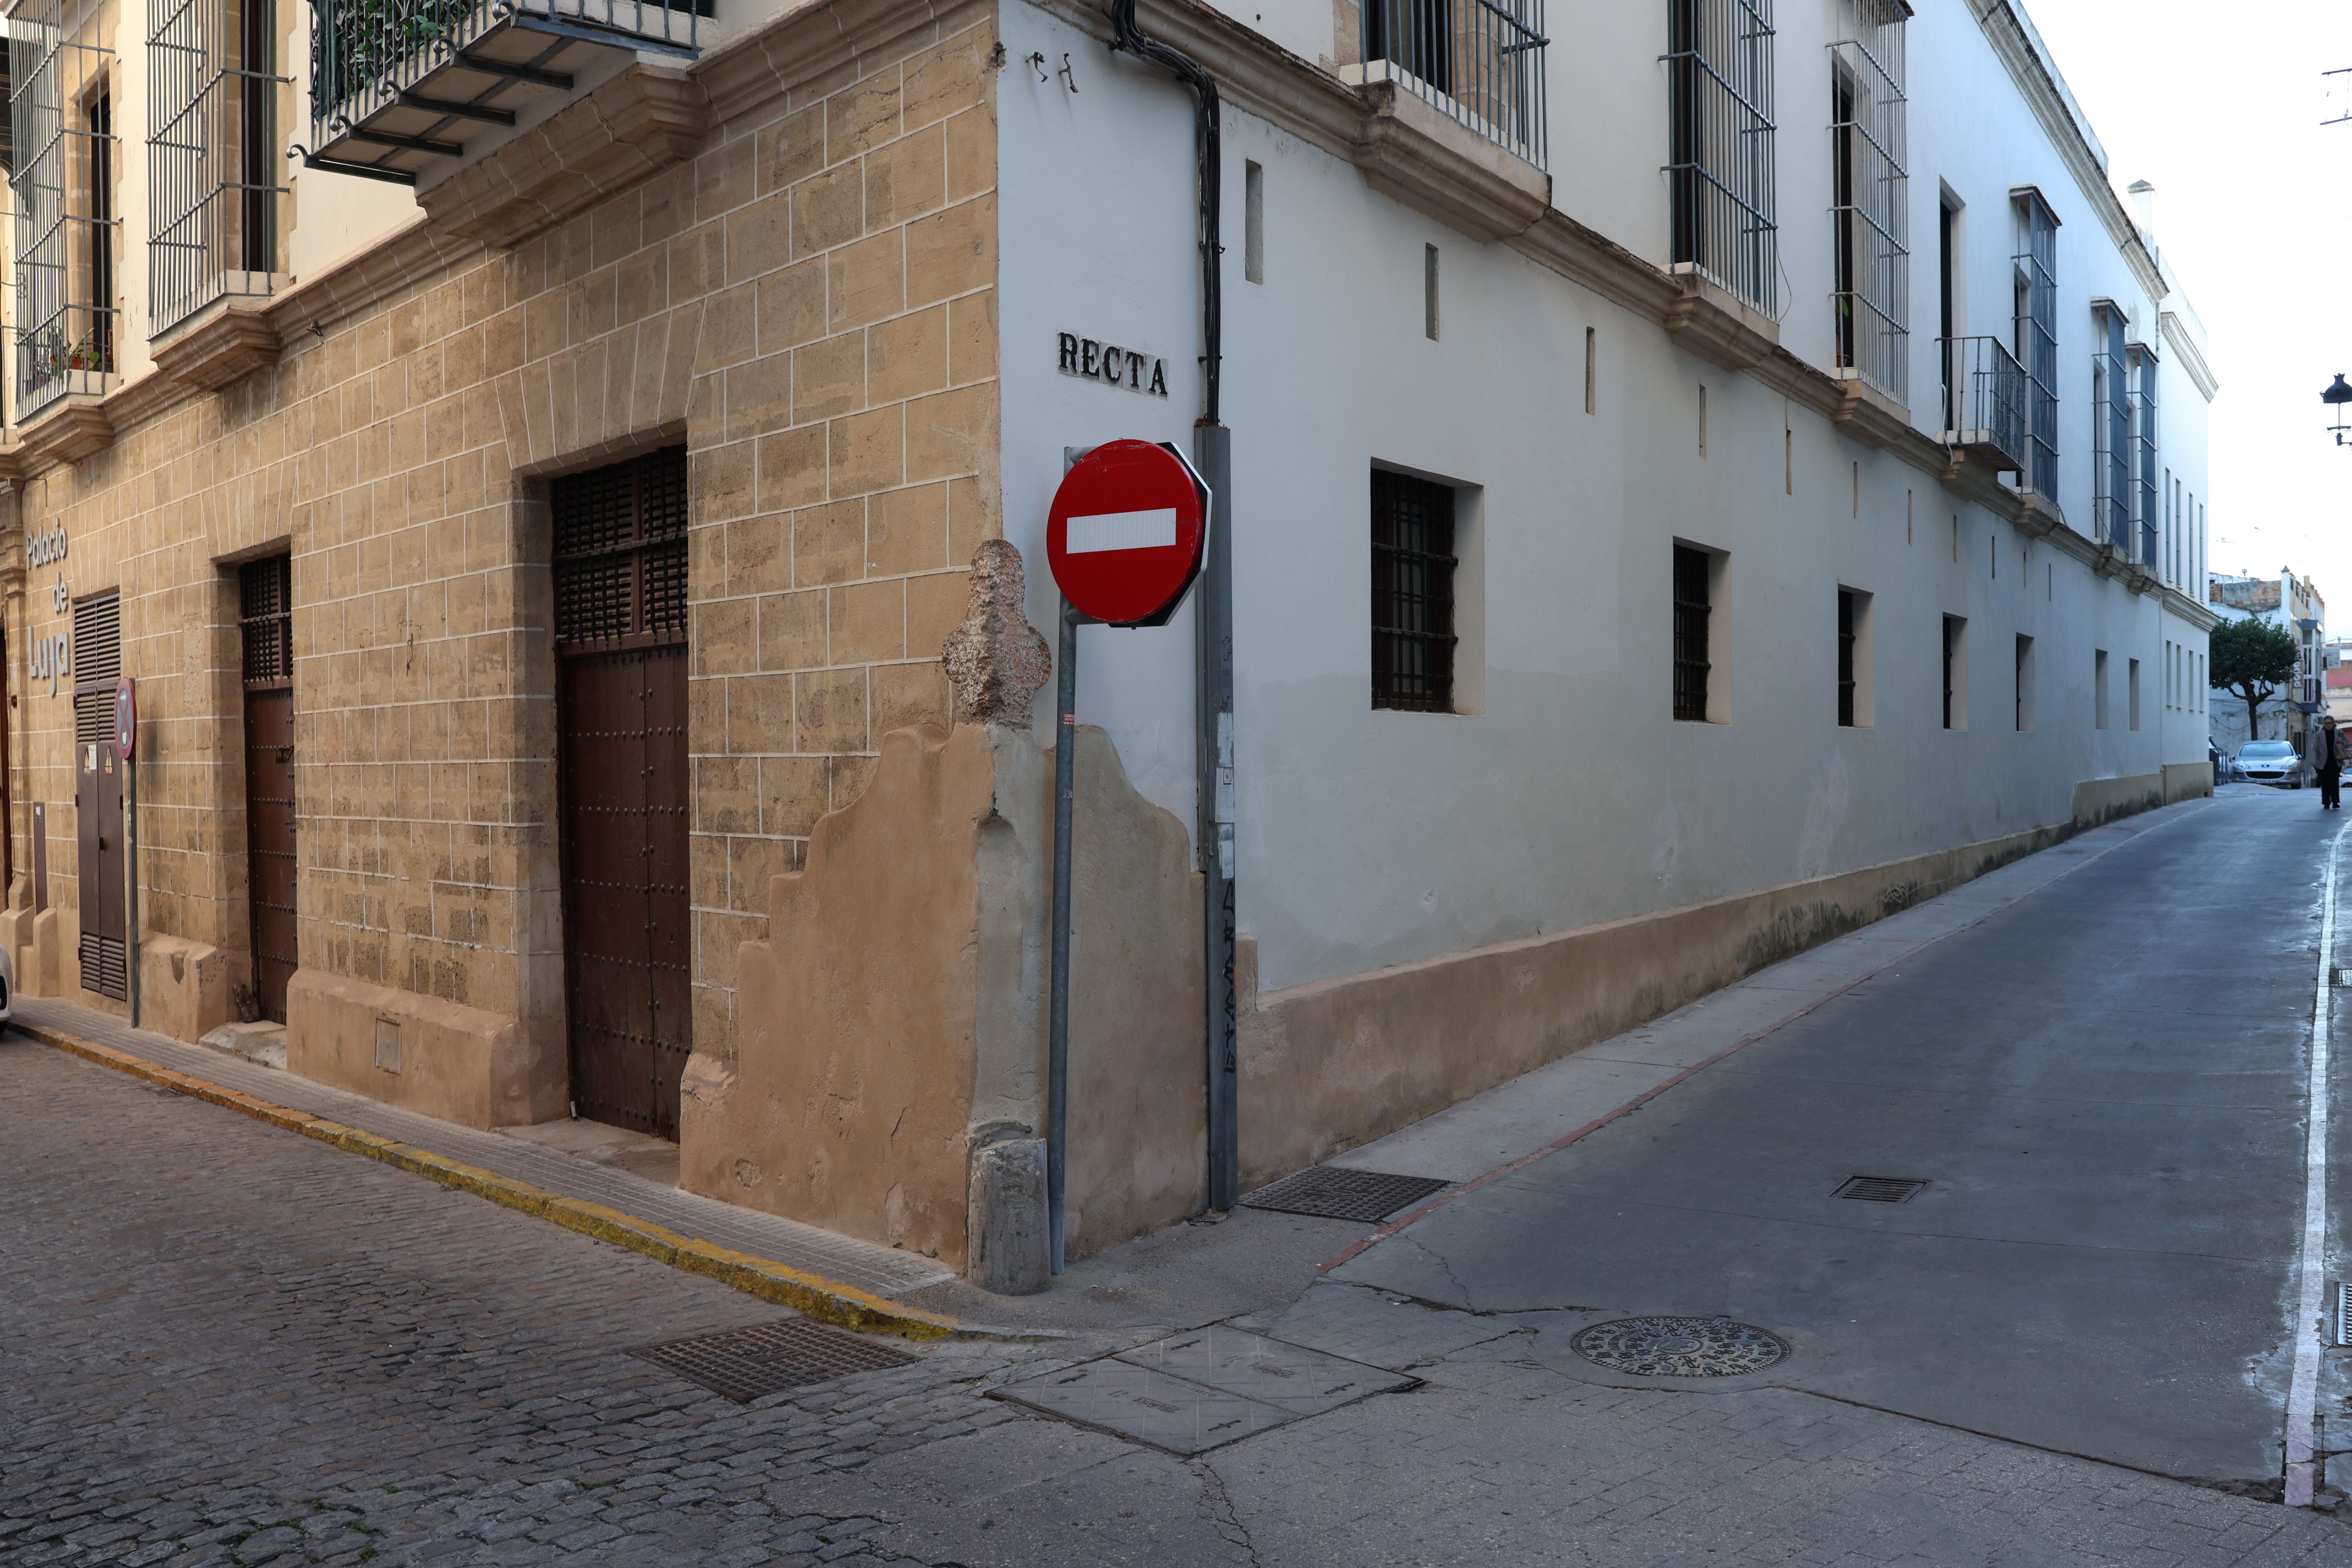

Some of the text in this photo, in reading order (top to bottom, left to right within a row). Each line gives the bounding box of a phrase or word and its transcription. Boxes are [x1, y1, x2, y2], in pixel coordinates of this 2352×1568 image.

[1058, 332, 1168, 397] RECTA
[26, 518, 67, 569] Palacio
[52, 573, 68, 613] de
[28, 626, 70, 697] Luja
[1715, 1343, 1756, 1365] APEMSA
